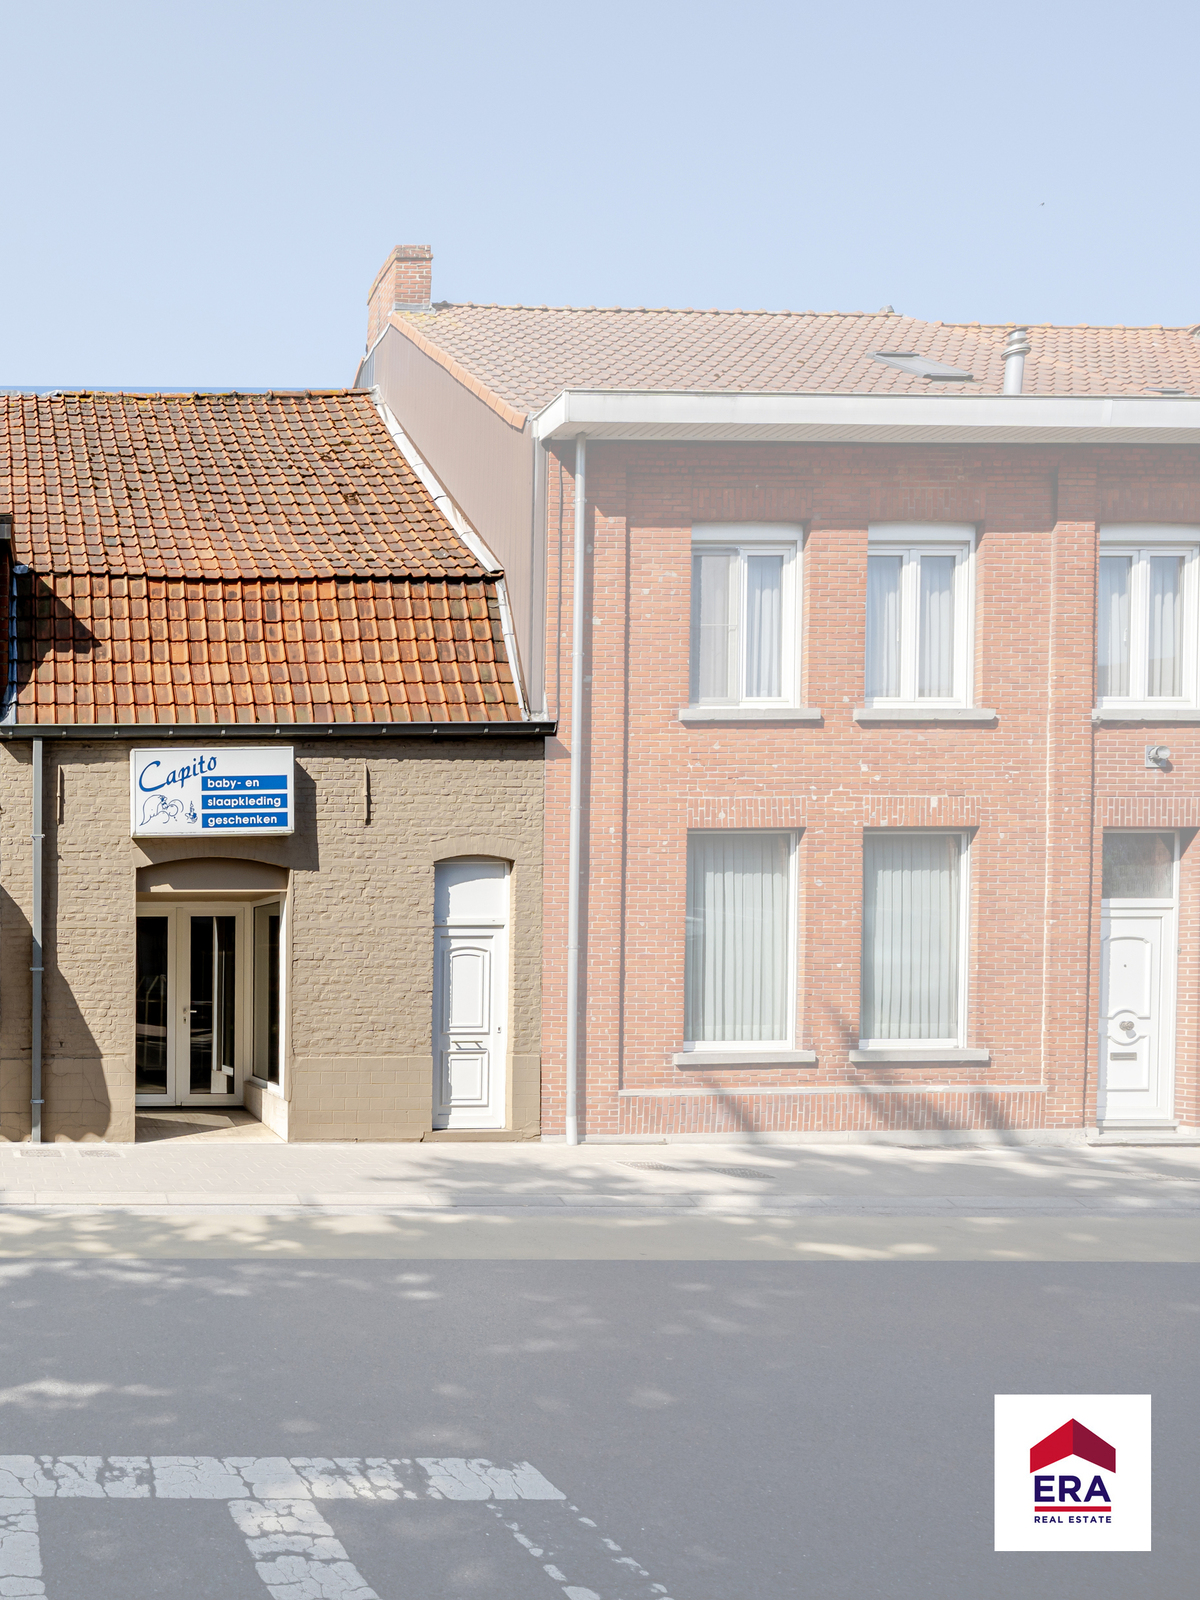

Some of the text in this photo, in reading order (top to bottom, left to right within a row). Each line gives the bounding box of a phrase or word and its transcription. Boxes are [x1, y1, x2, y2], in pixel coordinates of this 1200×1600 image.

[138, 754, 218, 793] Capito
[207, 778, 260, 789] baby- en
[207, 796, 282, 808] slaapkleding
[207, 815, 278, 827] geschenken
